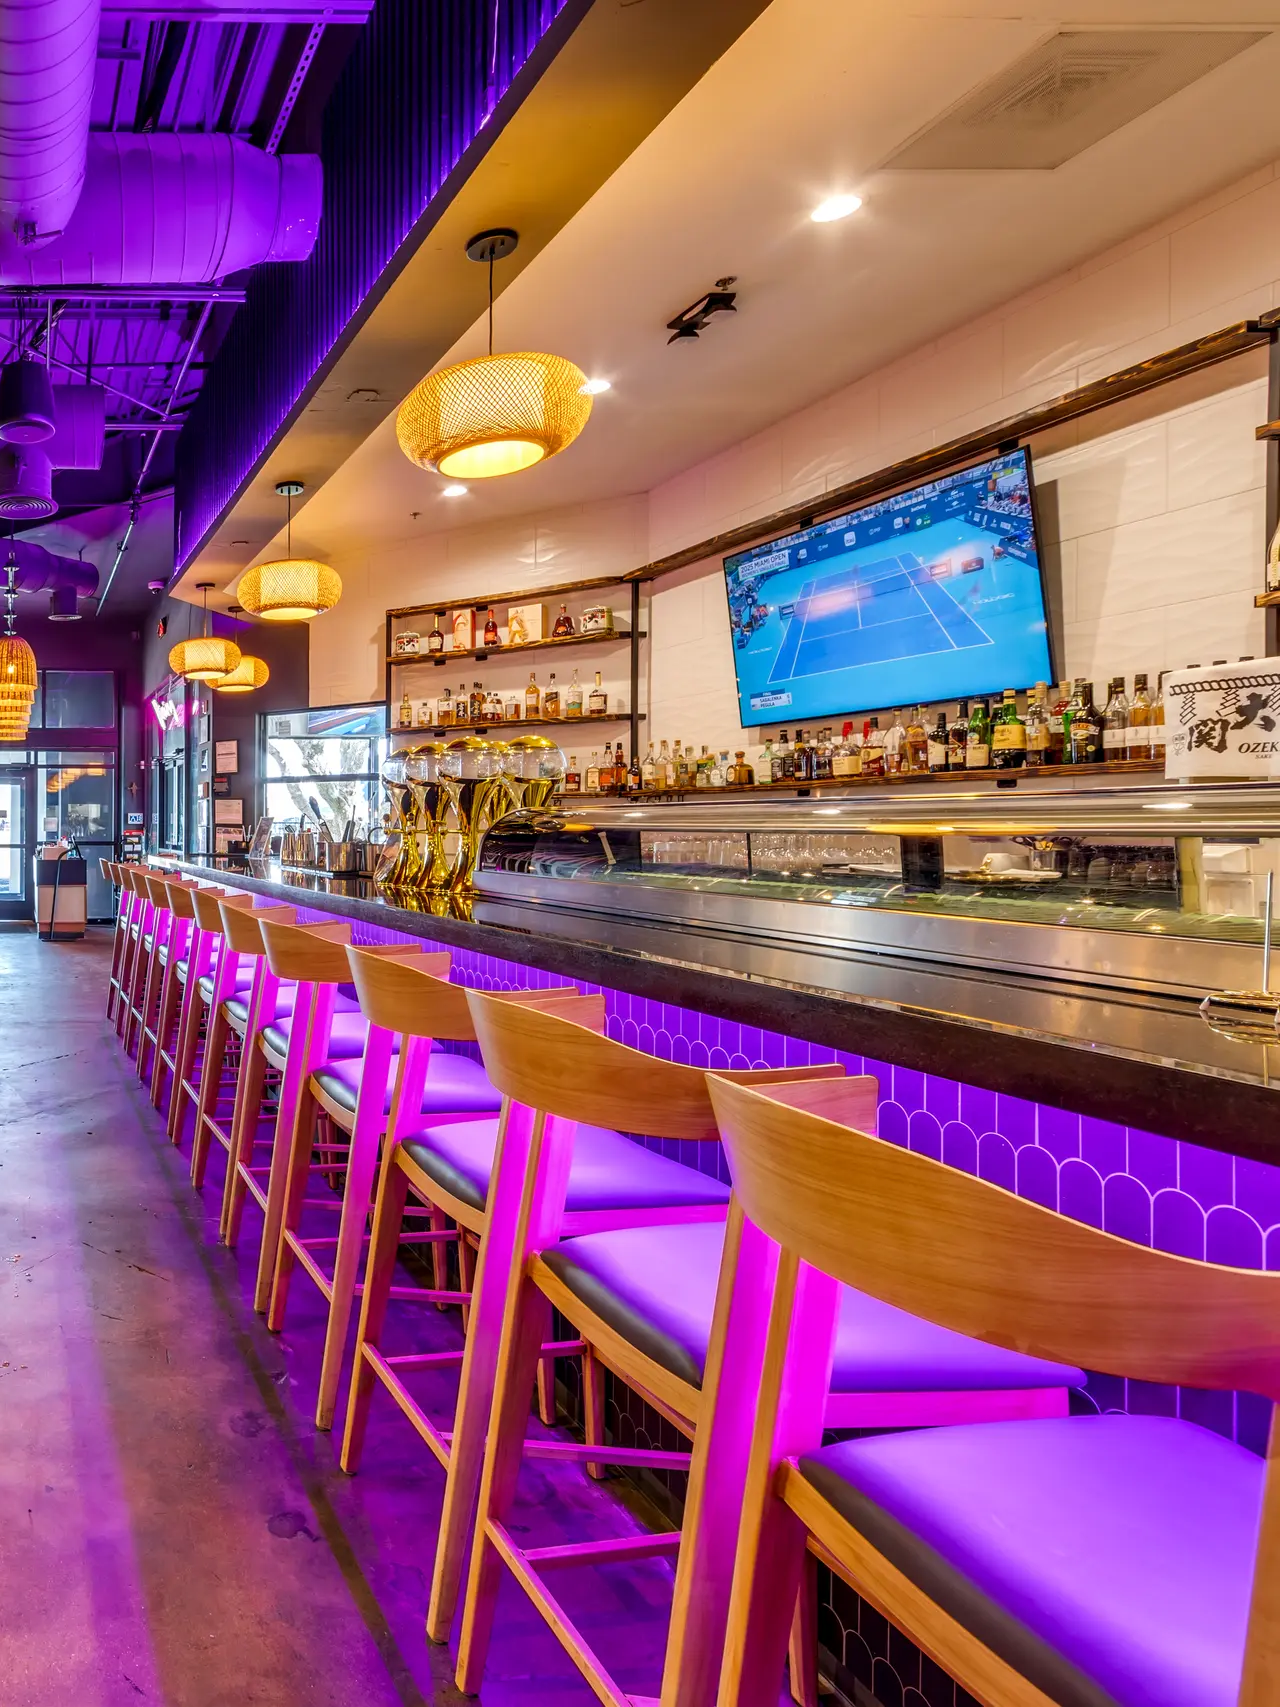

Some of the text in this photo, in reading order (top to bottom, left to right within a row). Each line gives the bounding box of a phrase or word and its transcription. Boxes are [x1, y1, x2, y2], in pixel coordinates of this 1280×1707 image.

[741, 553, 786, 573] 2025 MIAMI OPEN
[1238, 742, 1280, 754] OZEK
